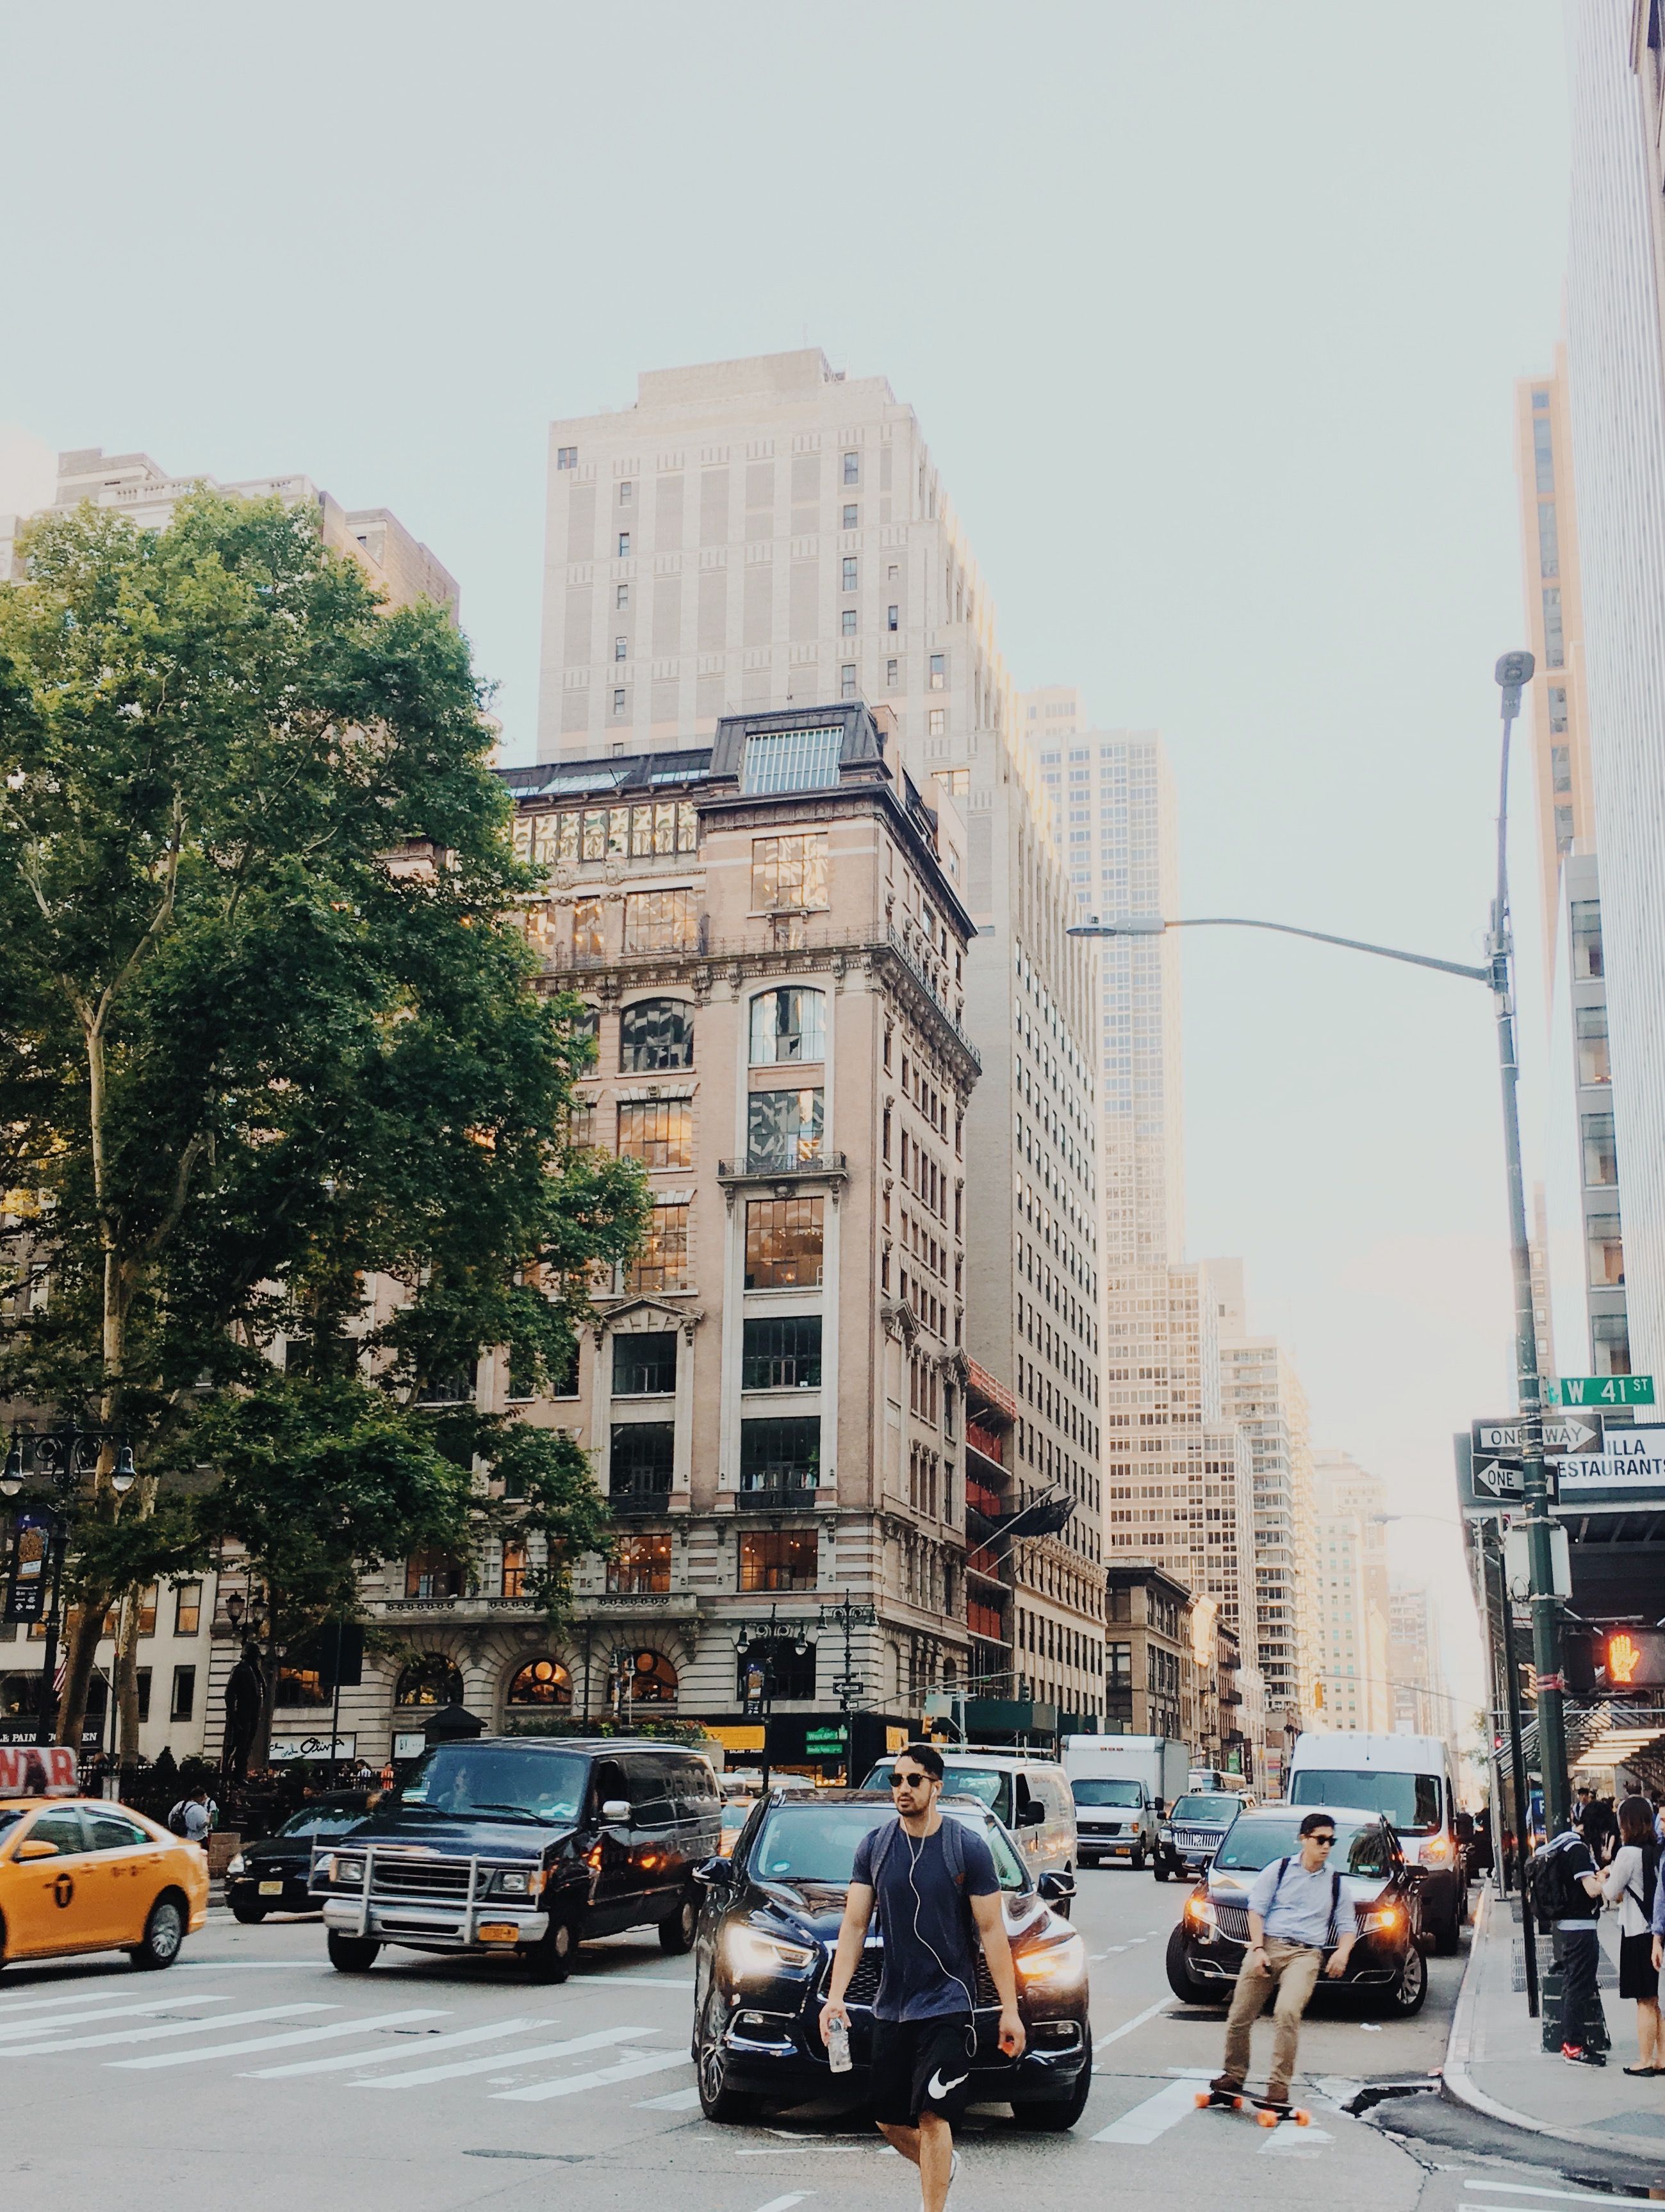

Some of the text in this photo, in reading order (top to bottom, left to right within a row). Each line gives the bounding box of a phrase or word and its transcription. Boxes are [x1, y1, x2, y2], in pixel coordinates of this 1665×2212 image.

[1567, 1378, 1648, 1404] W 41 ST
[1545, 1427, 1582, 1443] WAY
[1557, 1458, 1665, 1478] ESTAURANT
[1488, 1469, 1514, 1487] ONE
[12, 1733, 37, 1742] PAIN
